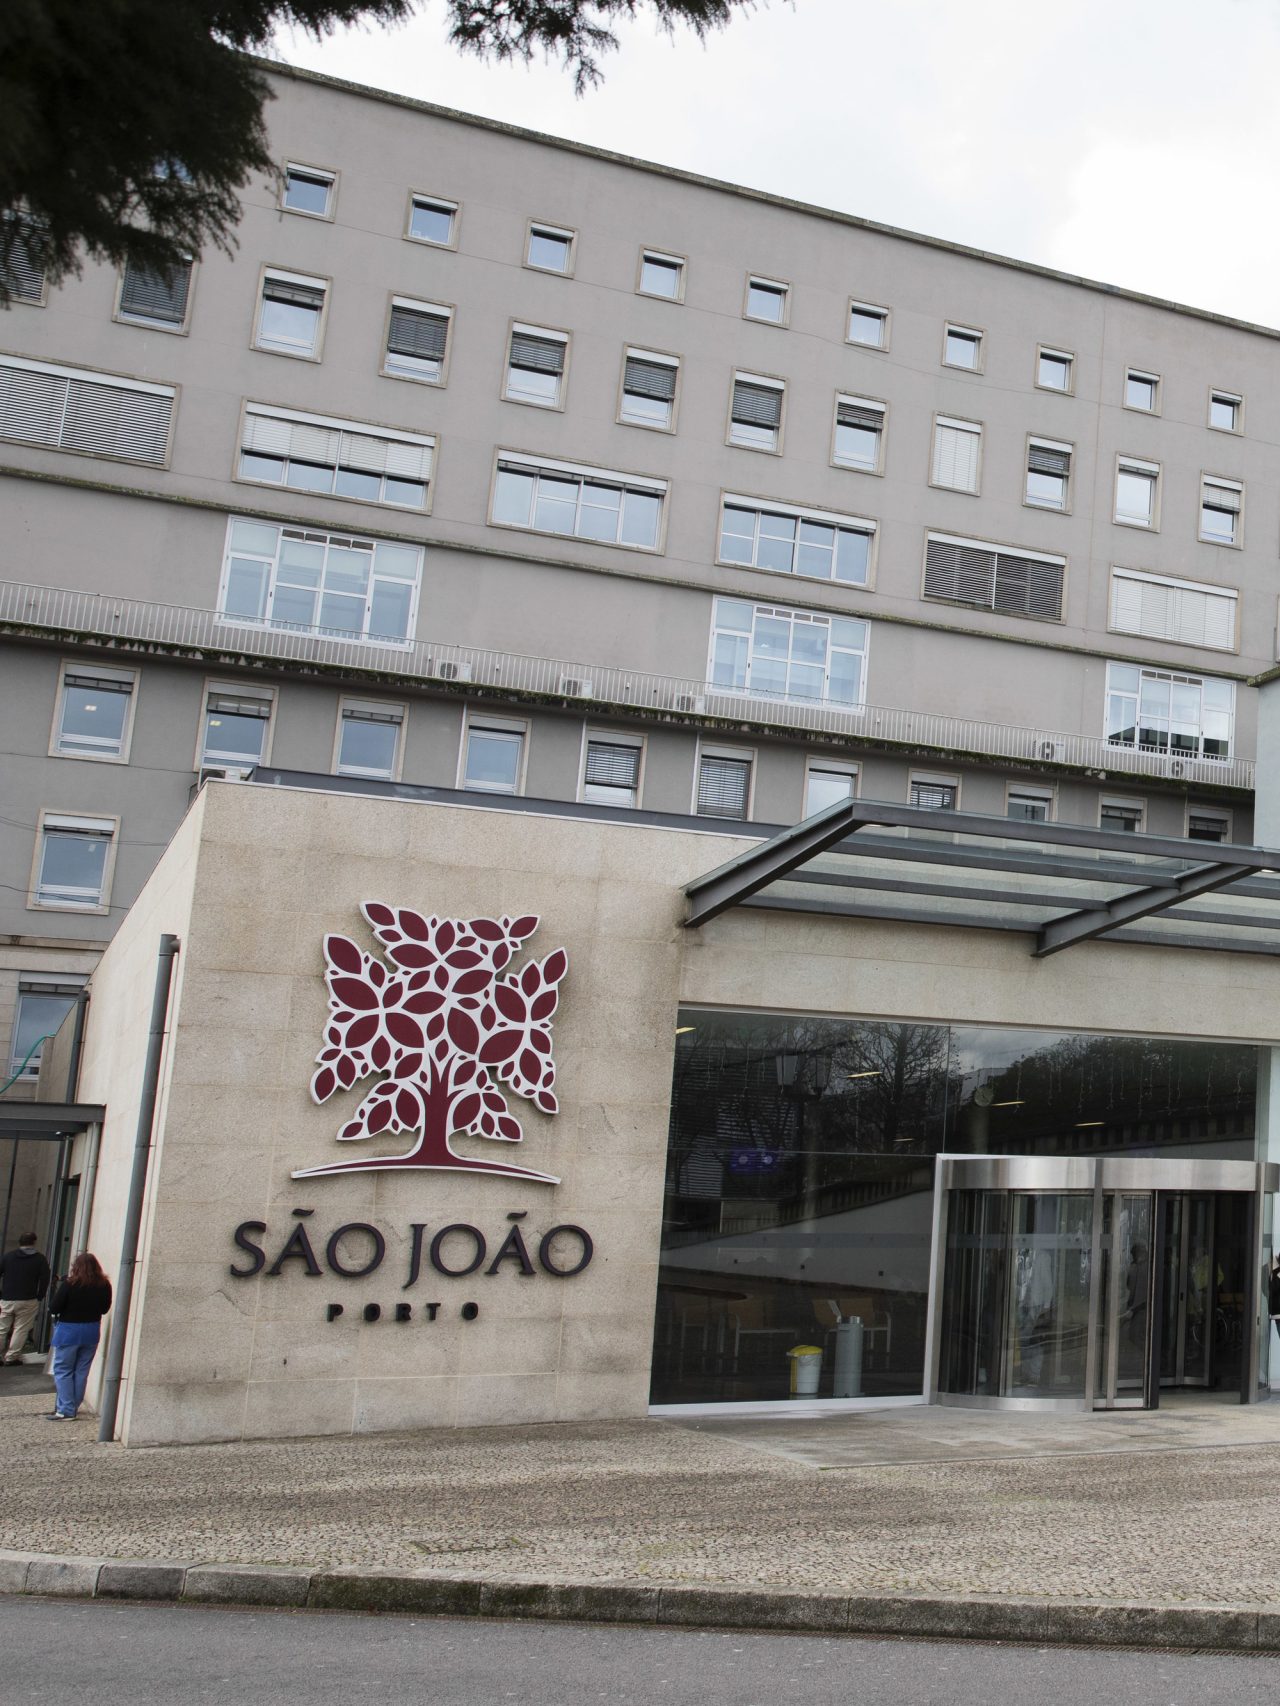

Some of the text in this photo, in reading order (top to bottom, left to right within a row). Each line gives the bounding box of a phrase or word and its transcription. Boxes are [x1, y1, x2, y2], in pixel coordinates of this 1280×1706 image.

[230, 1208, 595, 1291] SÃO JOÃO
[327, 1302, 479, 1323] PORTO
